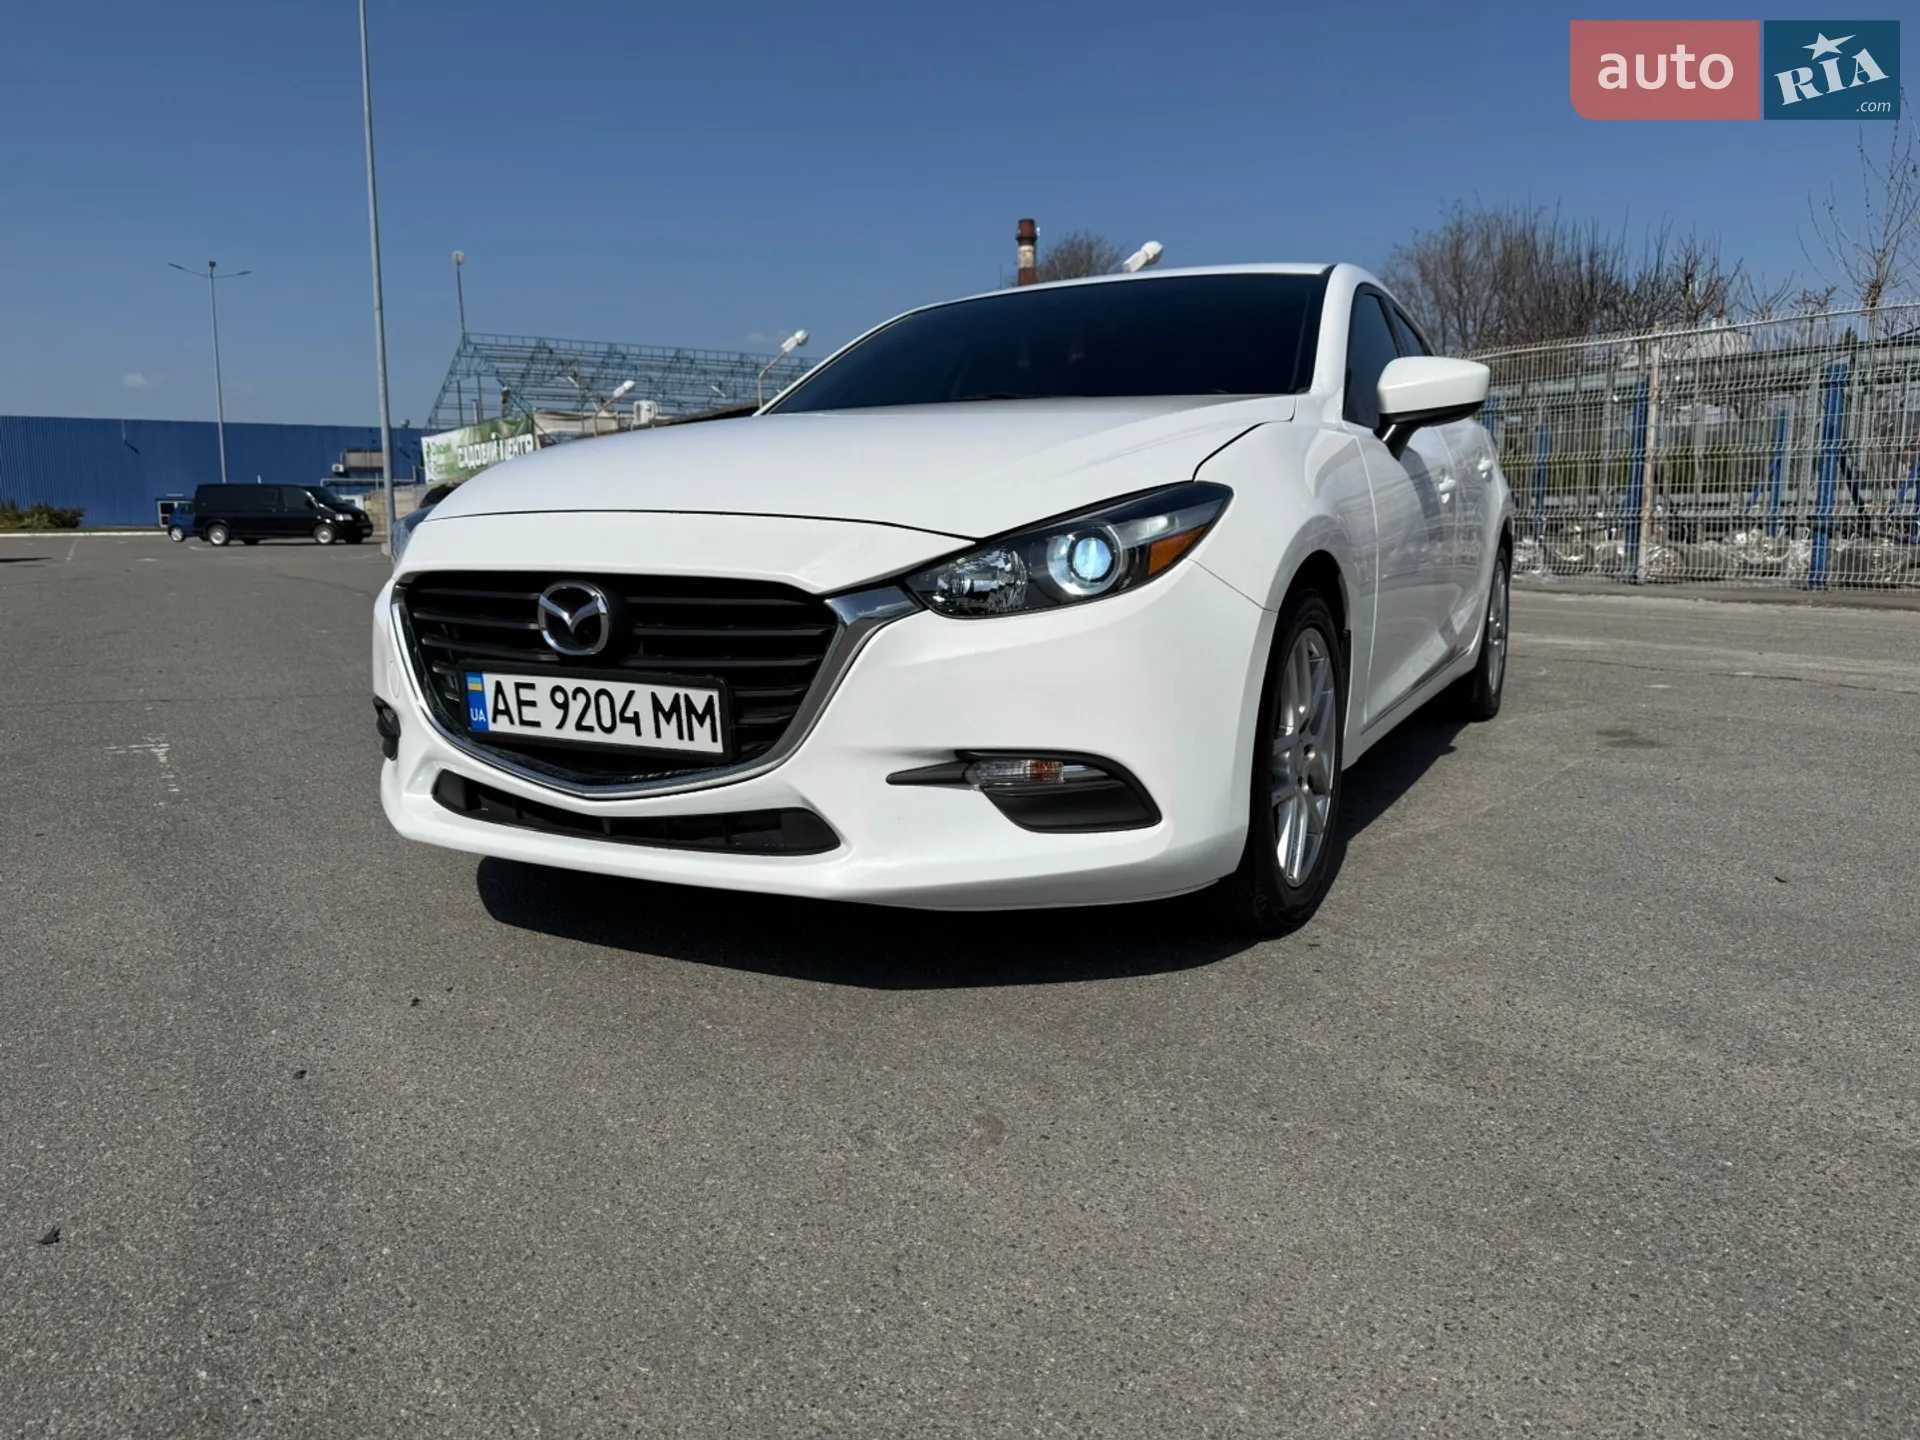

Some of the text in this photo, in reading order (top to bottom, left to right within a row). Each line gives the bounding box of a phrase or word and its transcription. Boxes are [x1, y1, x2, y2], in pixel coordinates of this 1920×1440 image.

[470, 707, 487, 723] UA
[491, 680, 719, 743] AE 9204 MM
